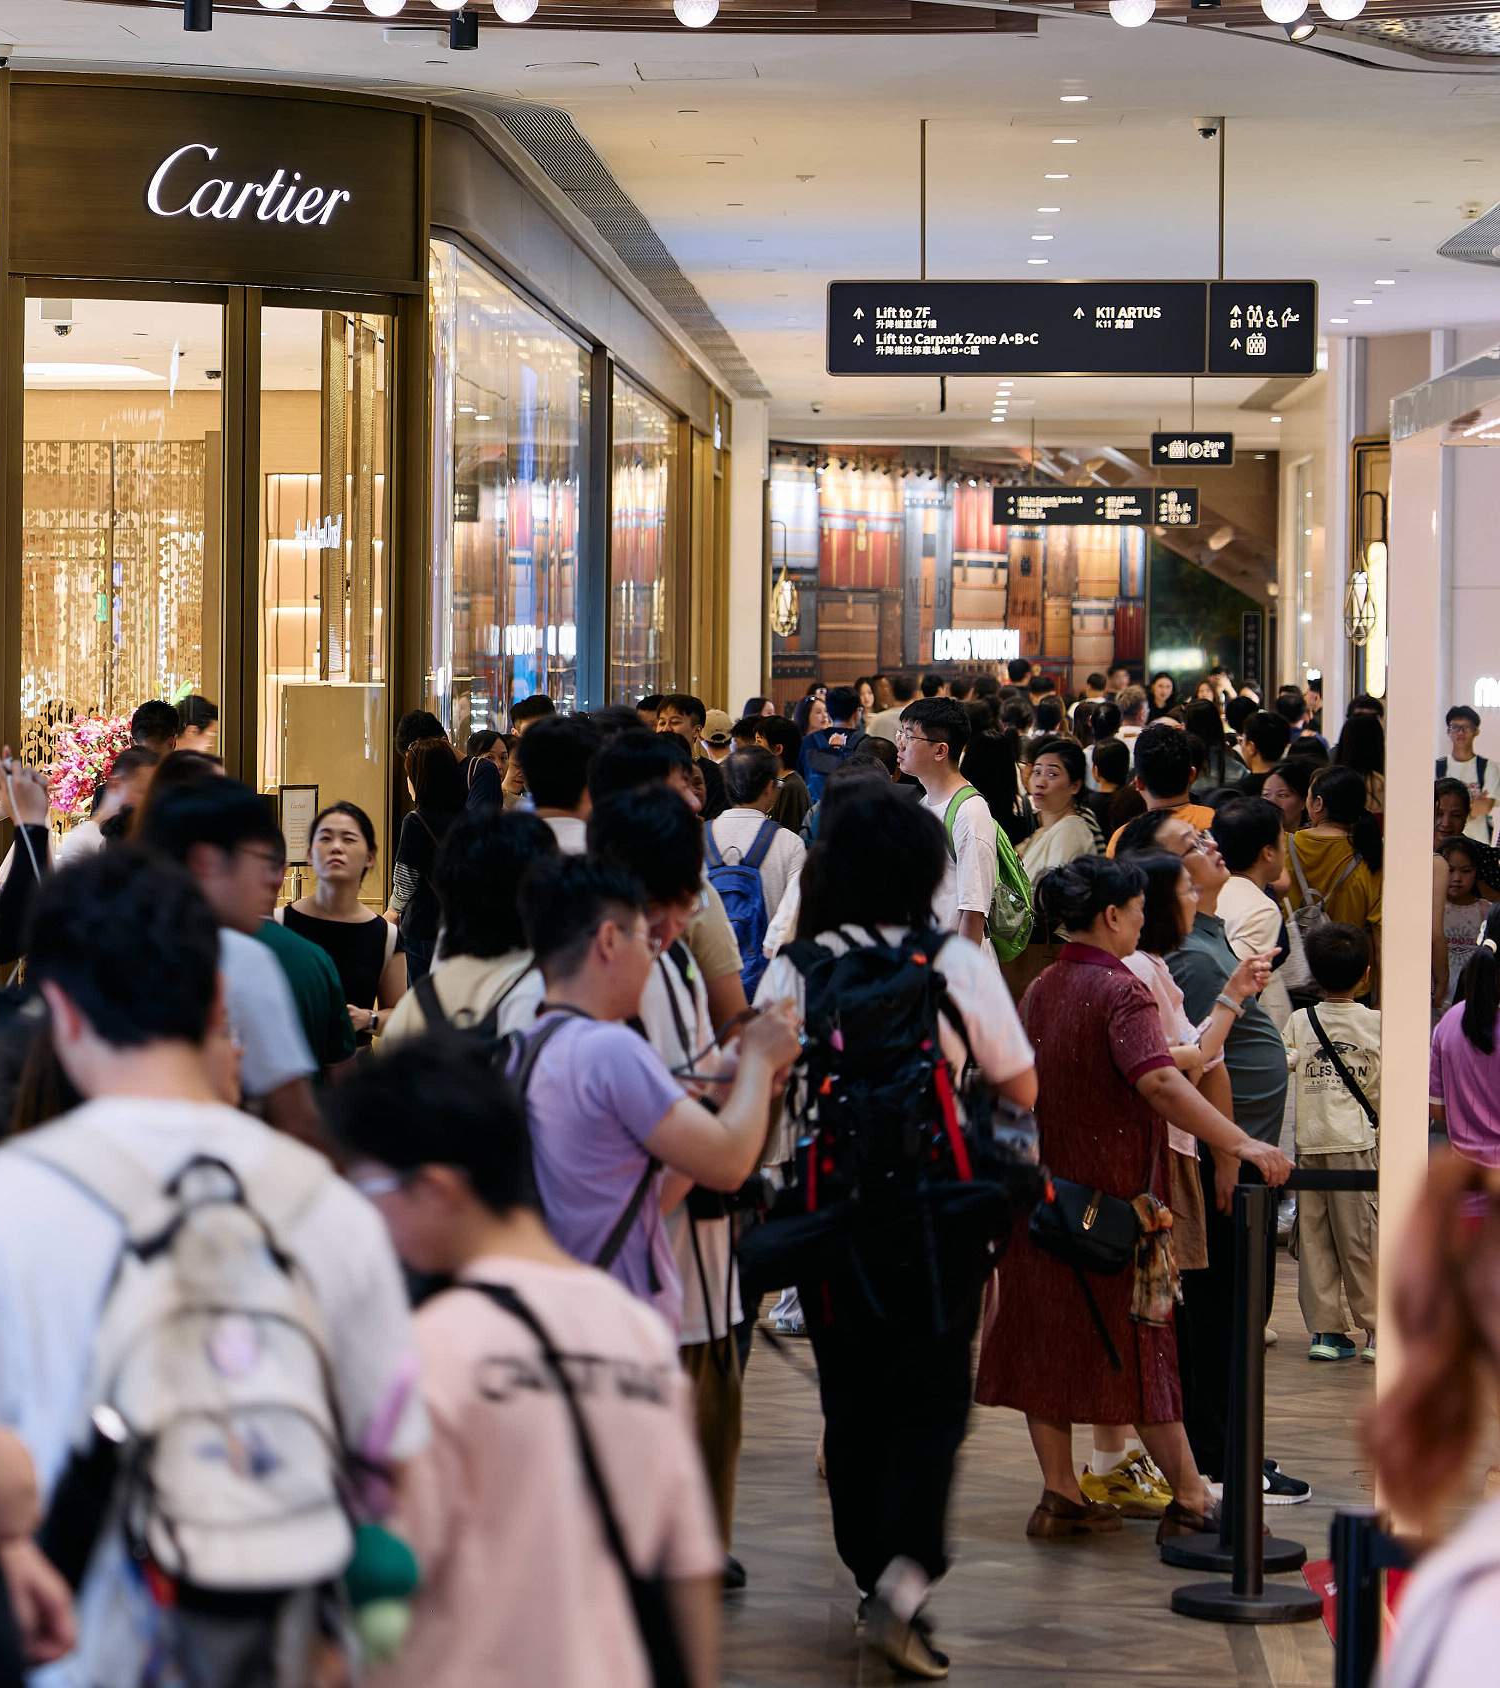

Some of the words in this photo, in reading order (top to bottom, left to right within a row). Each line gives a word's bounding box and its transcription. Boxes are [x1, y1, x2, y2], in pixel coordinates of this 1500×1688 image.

[147, 143, 350, 225] Cartier
[876, 307, 897, 318] Lift
[899, 307, 913, 319] to
[915, 307, 931, 319] 7F
[1096, 306, 1115, 319] K11
[1117, 306, 1161, 319] ARTUS
[1095, 320, 1112, 329] K11
[1230, 318, 1241, 328] B1
[876, 333, 897, 345] Lift
[899, 333, 913, 345] to
[914, 333, 964, 347] Carpark
[965, 333, 997, 345] Zone
[1203, 440, 1225, 449] Zone
[934, 628, 971, 661] LOUIS
[970, 628, 1020, 661] VUITTON
